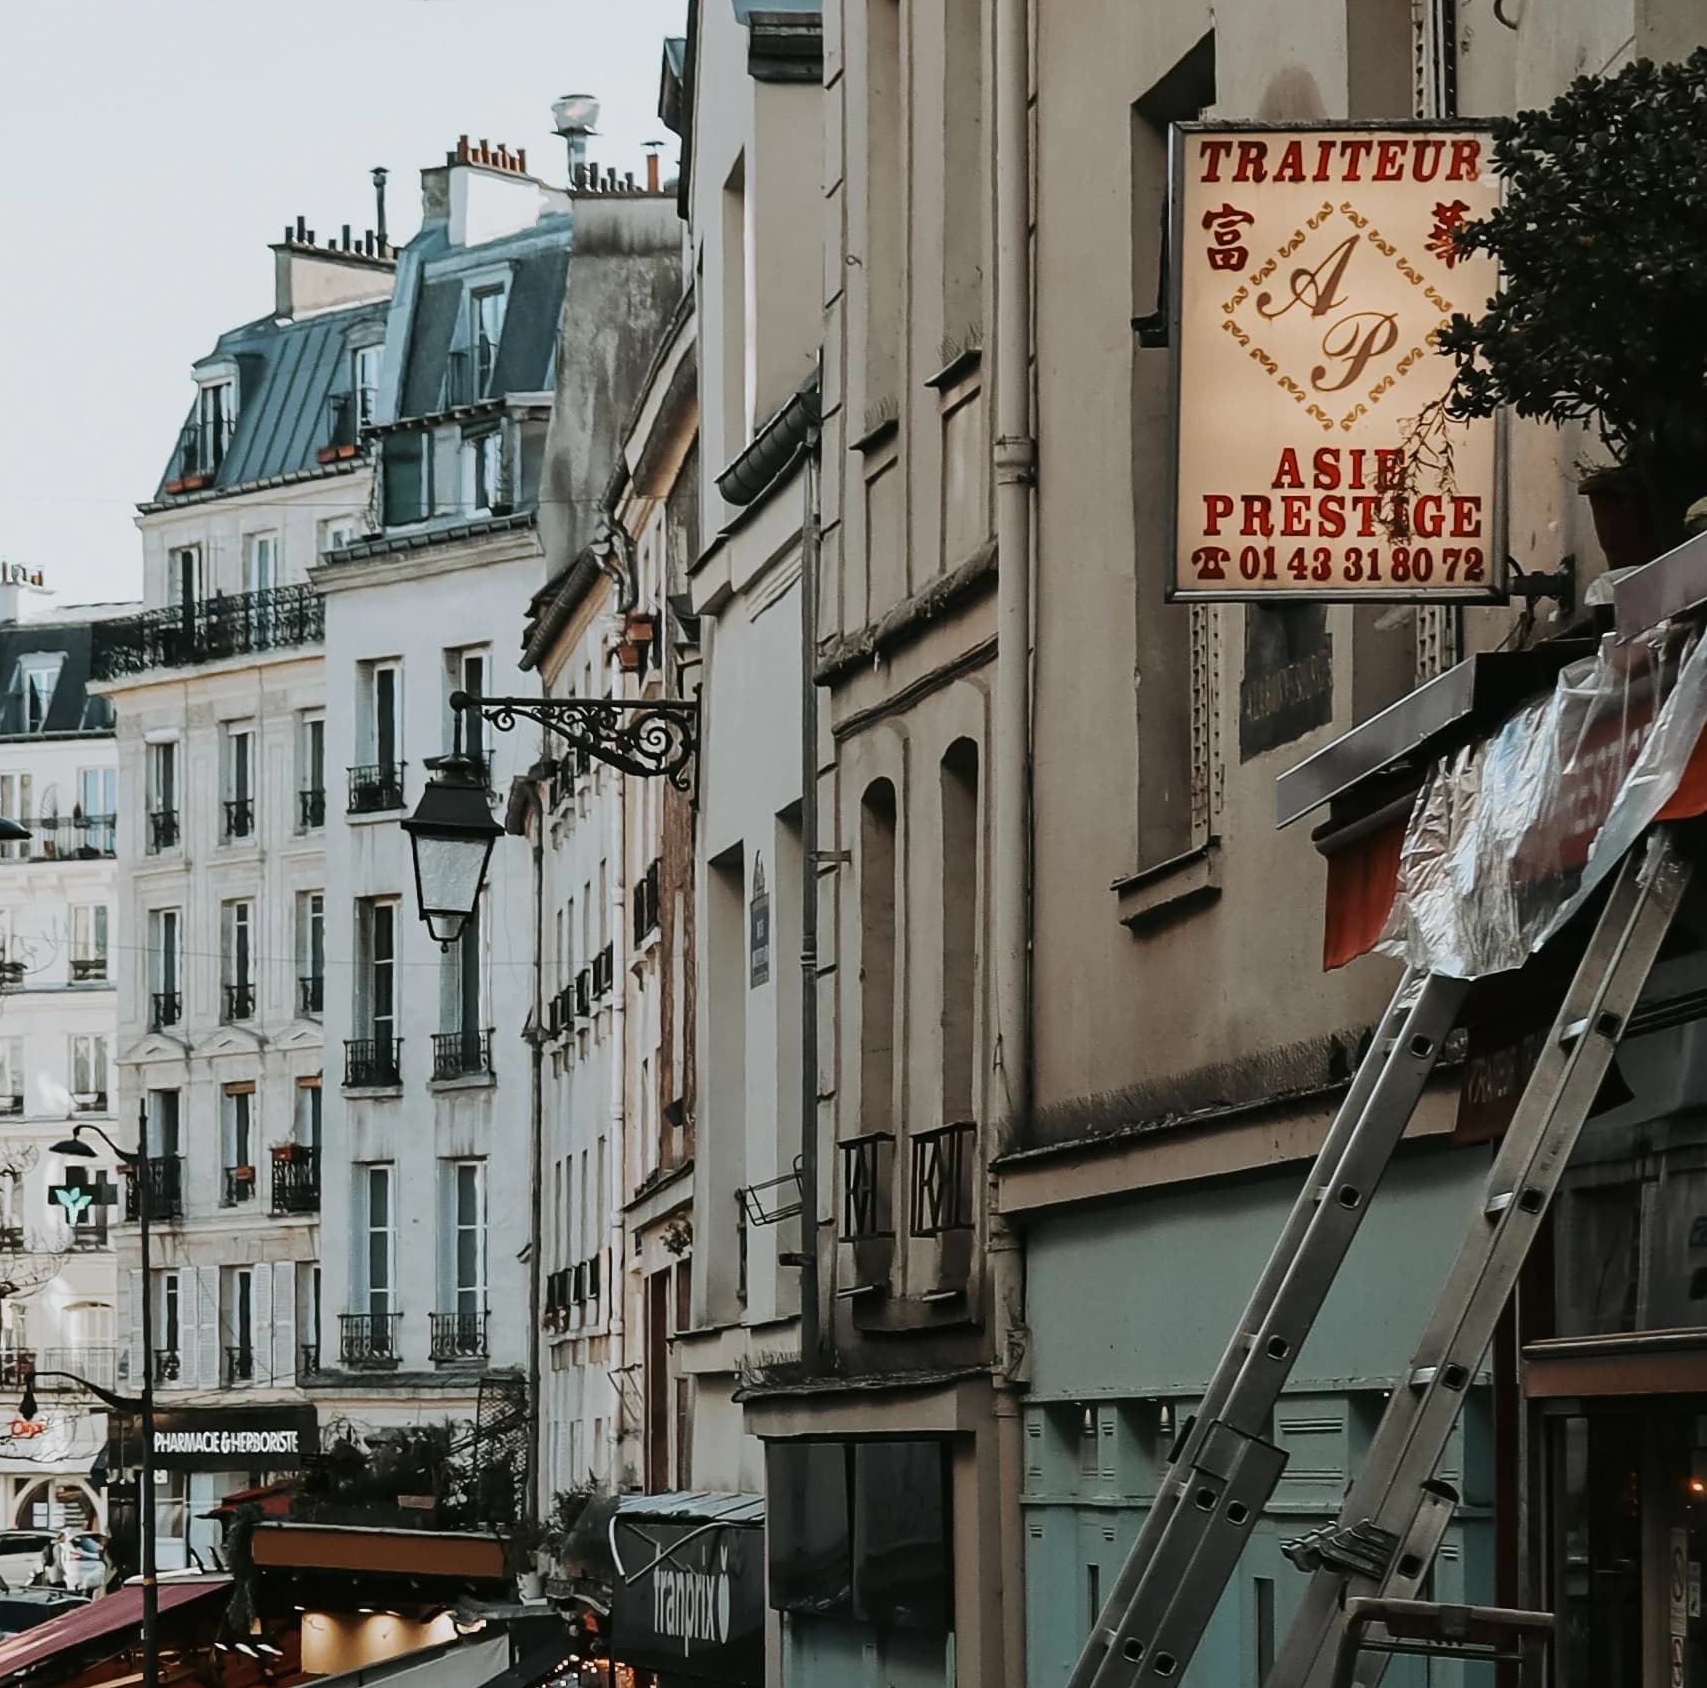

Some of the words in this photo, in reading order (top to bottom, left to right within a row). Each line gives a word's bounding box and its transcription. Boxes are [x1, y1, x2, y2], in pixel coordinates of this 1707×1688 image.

[1200, 139, 1482, 183] TRAITEUR
[1201, 203, 1255, 273] 富
[1256, 233, 1362, 319] A
[1310, 311, 1400, 393] P
[1272, 446, 1406, 491] ASIE
[1202, 494, 1483, 538] PRESTIGE
[1239, 545, 1279, 582] 01
[1287, 546, 1332, 582] 43
[1343, 545, 1383, 582] 31
[1390, 545, 1434, 582] 80
[1441, 545, 1485, 583] 72
[653, 1543, 716, 1658] franprix
